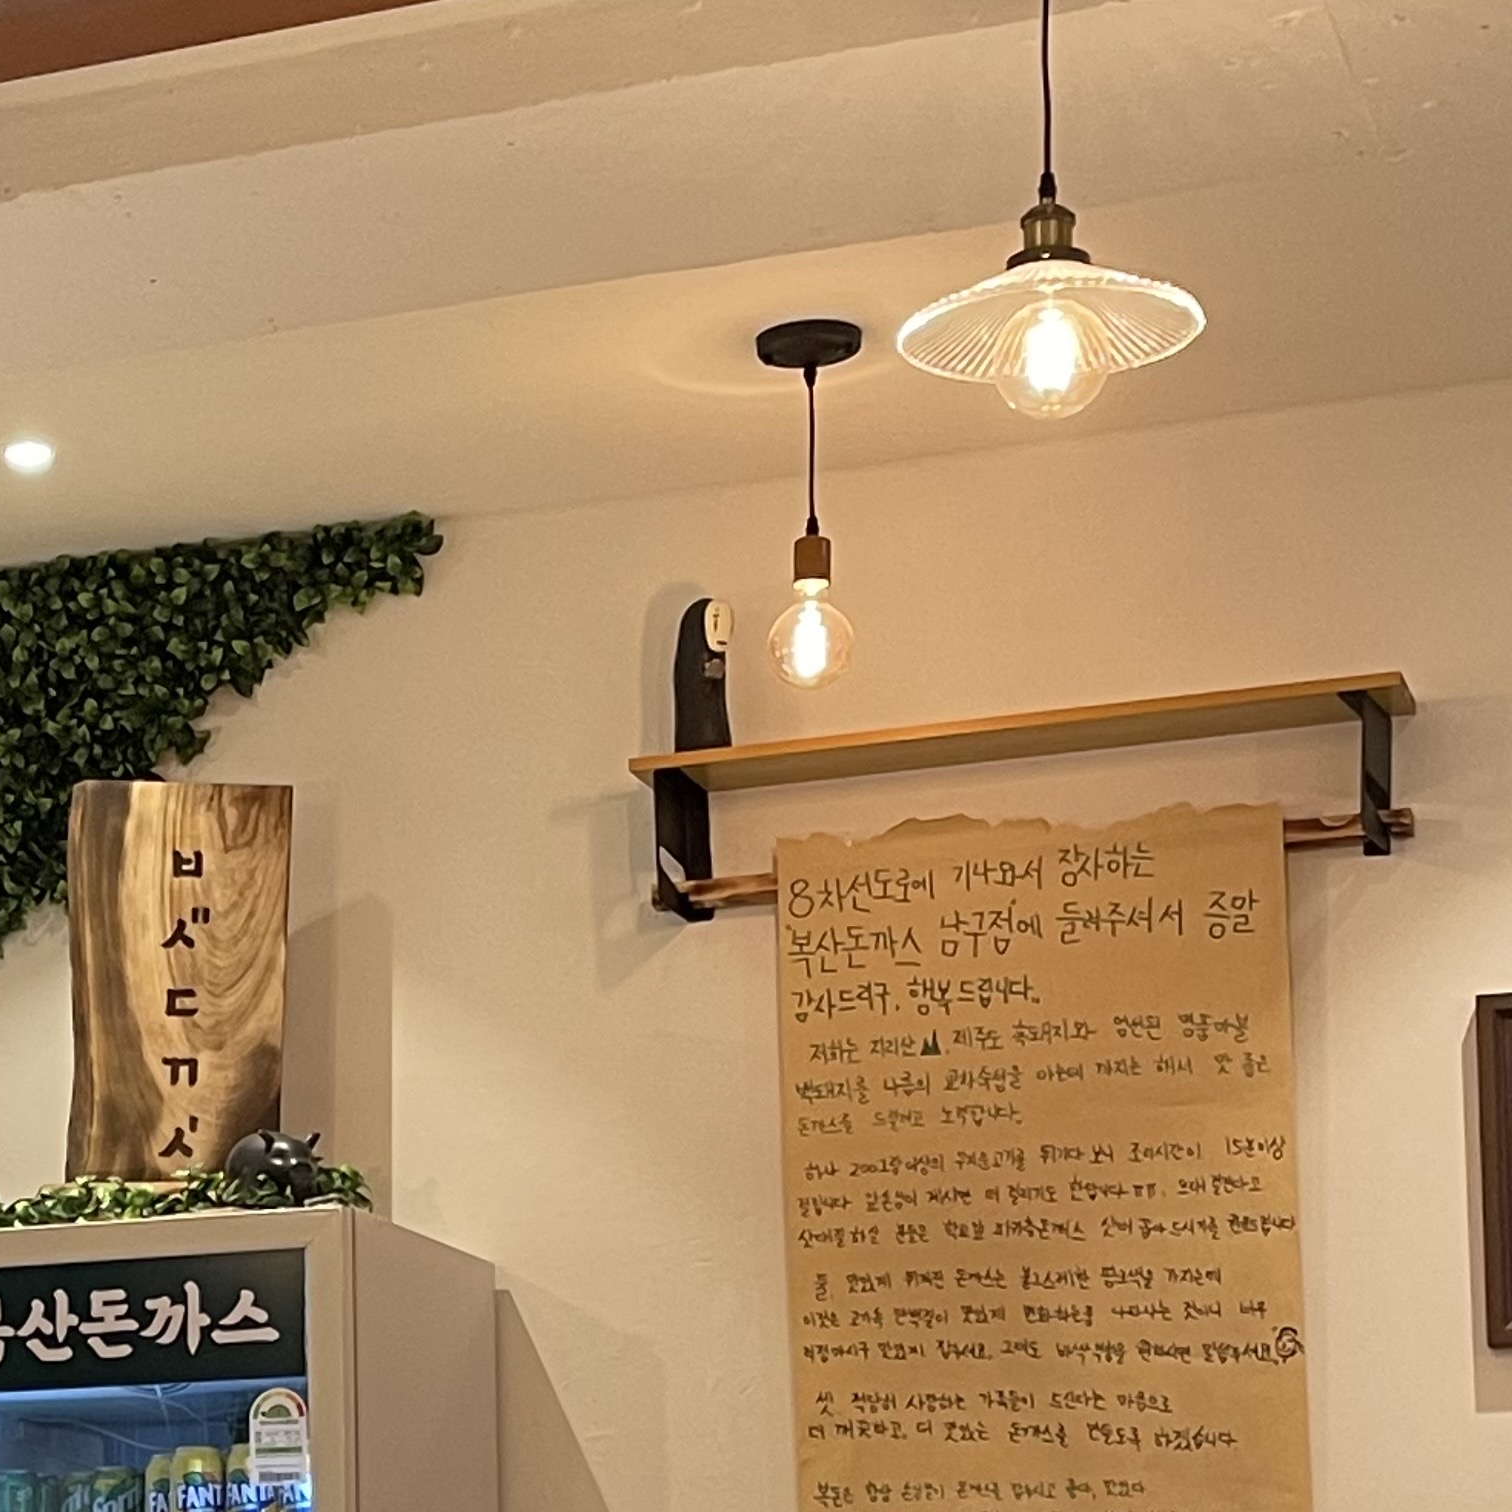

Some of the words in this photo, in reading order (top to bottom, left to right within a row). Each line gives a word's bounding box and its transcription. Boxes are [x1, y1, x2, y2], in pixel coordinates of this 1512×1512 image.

[788, 868, 935, 919] 8차선도로에
[1058, 841, 1155, 888] 장사하는
[869, 1032, 917, 1058] 지리산
[952, 1025, 1004, 1051] 제주도
[1012, 1016, 1098, 1046] 흑돼지와
[883, 1070, 931, 1098] 나름의
[178, 1482, 223, 1512] FANT
